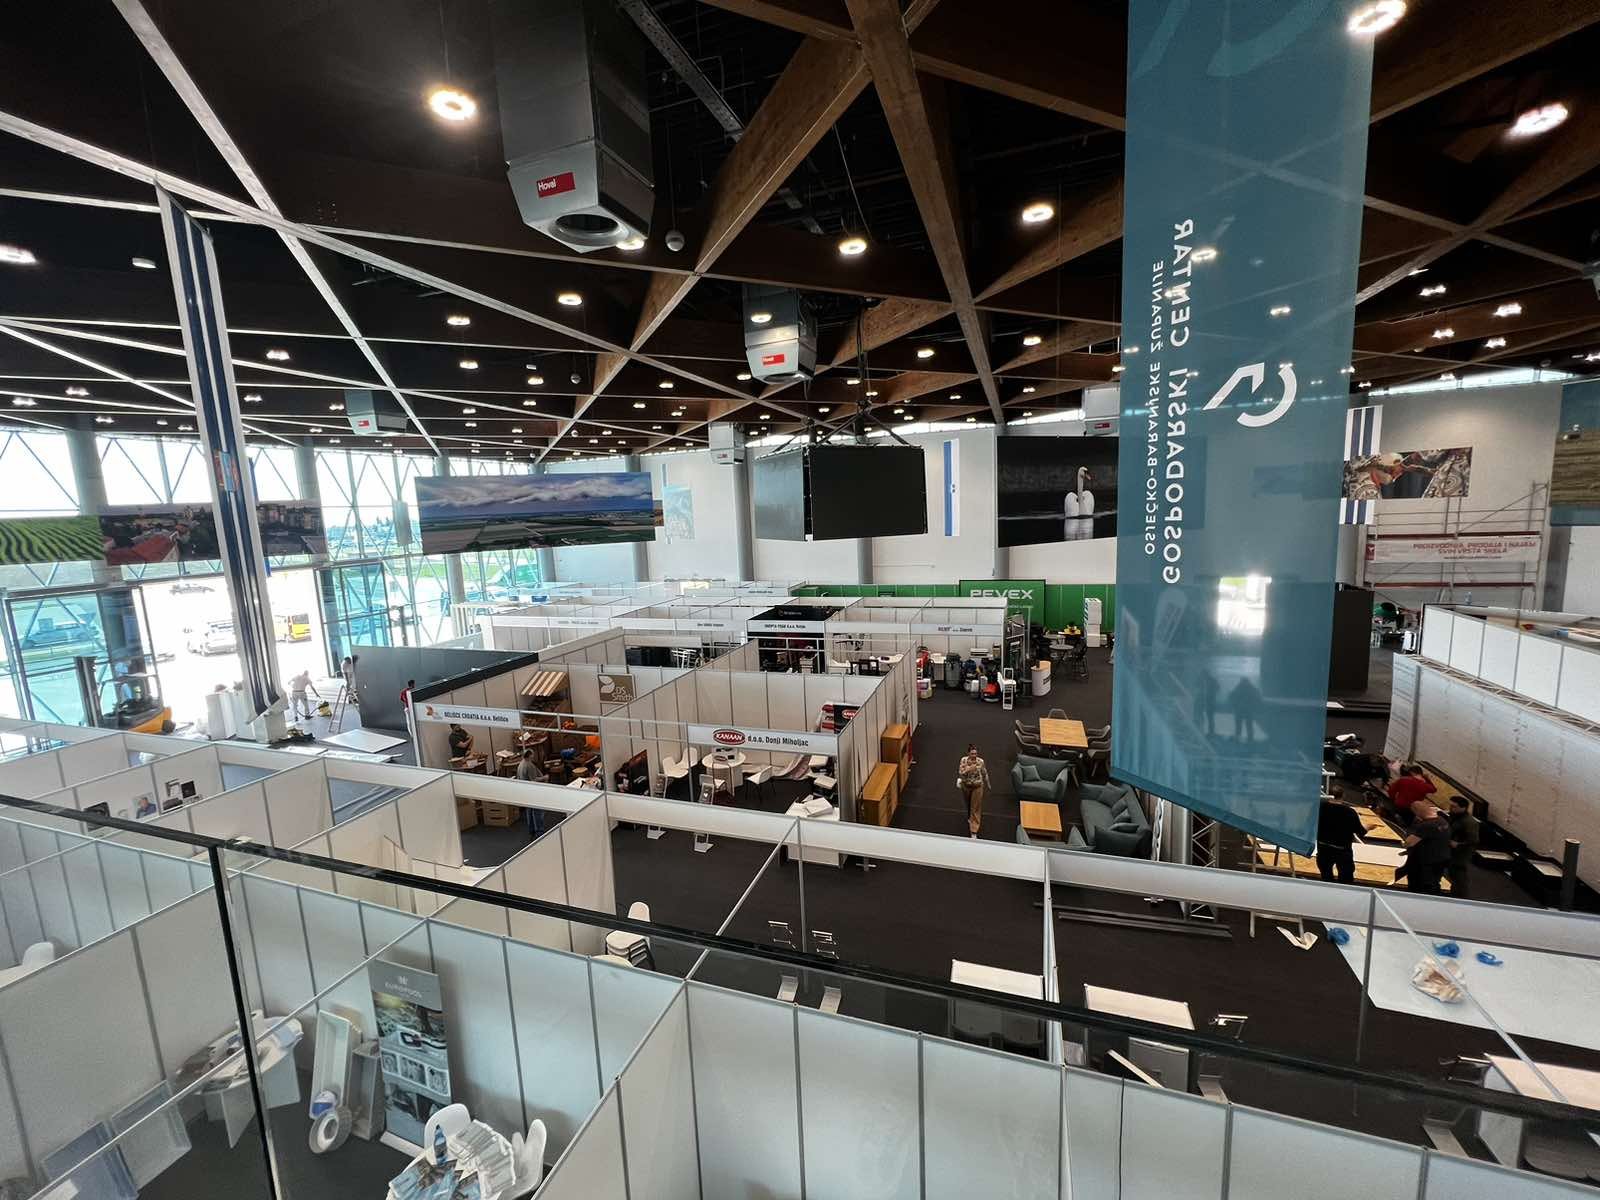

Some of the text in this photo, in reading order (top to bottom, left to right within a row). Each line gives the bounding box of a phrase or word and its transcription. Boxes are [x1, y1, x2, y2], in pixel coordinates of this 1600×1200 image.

[538, 179, 557, 191] Hoval
[970, 589, 1033, 600] PEVEX
[612, 693, 633, 701] Smith
[715, 732, 743, 741] KANAAN
[765, 737, 781, 745] Donji
[782, 738, 809, 747] Miholjac
